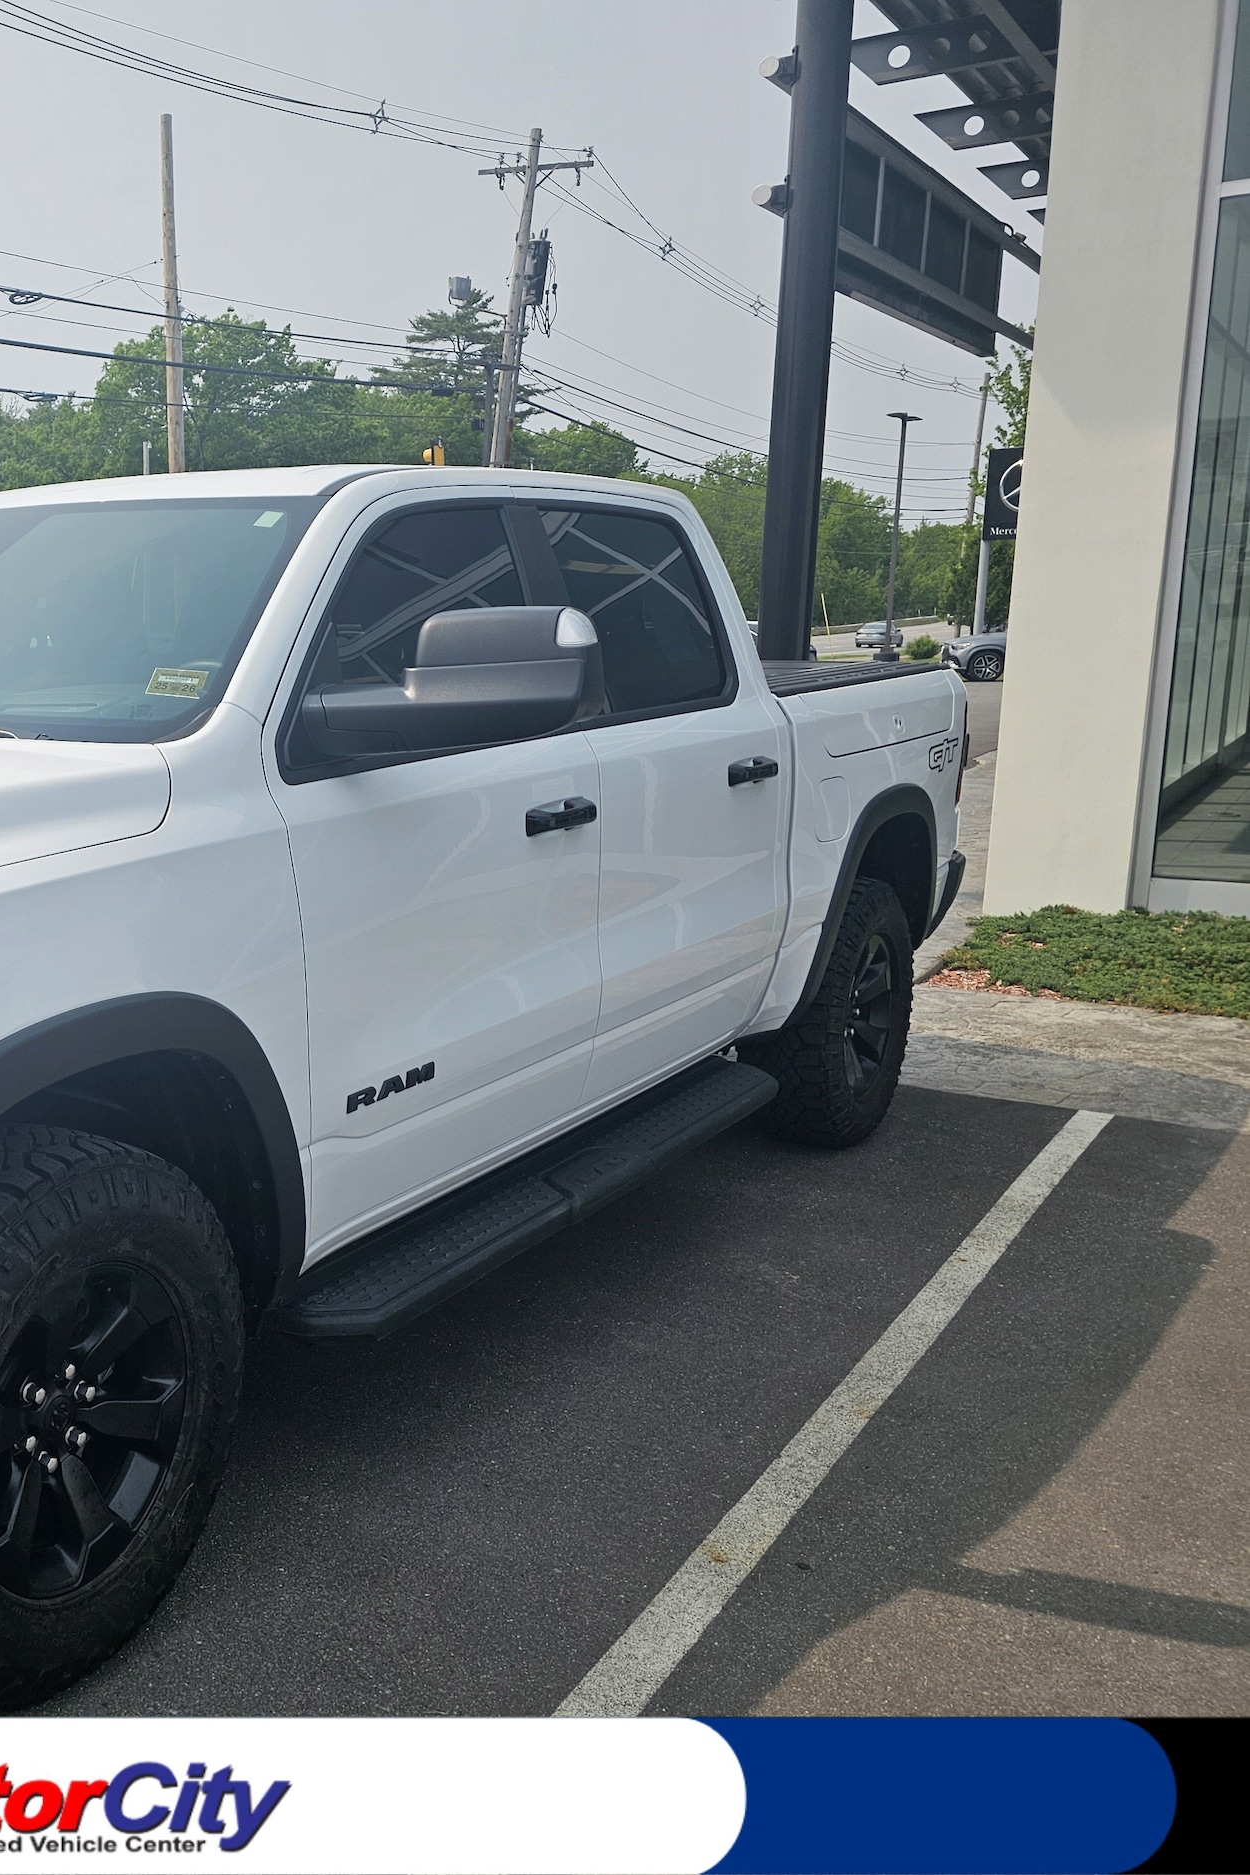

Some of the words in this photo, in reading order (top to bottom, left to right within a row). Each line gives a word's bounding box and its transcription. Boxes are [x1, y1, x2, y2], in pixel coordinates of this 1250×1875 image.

[155, 682, 169, 690] 25
[181, 684, 197, 693] 26
[346, 1061, 435, 1115] RAM
